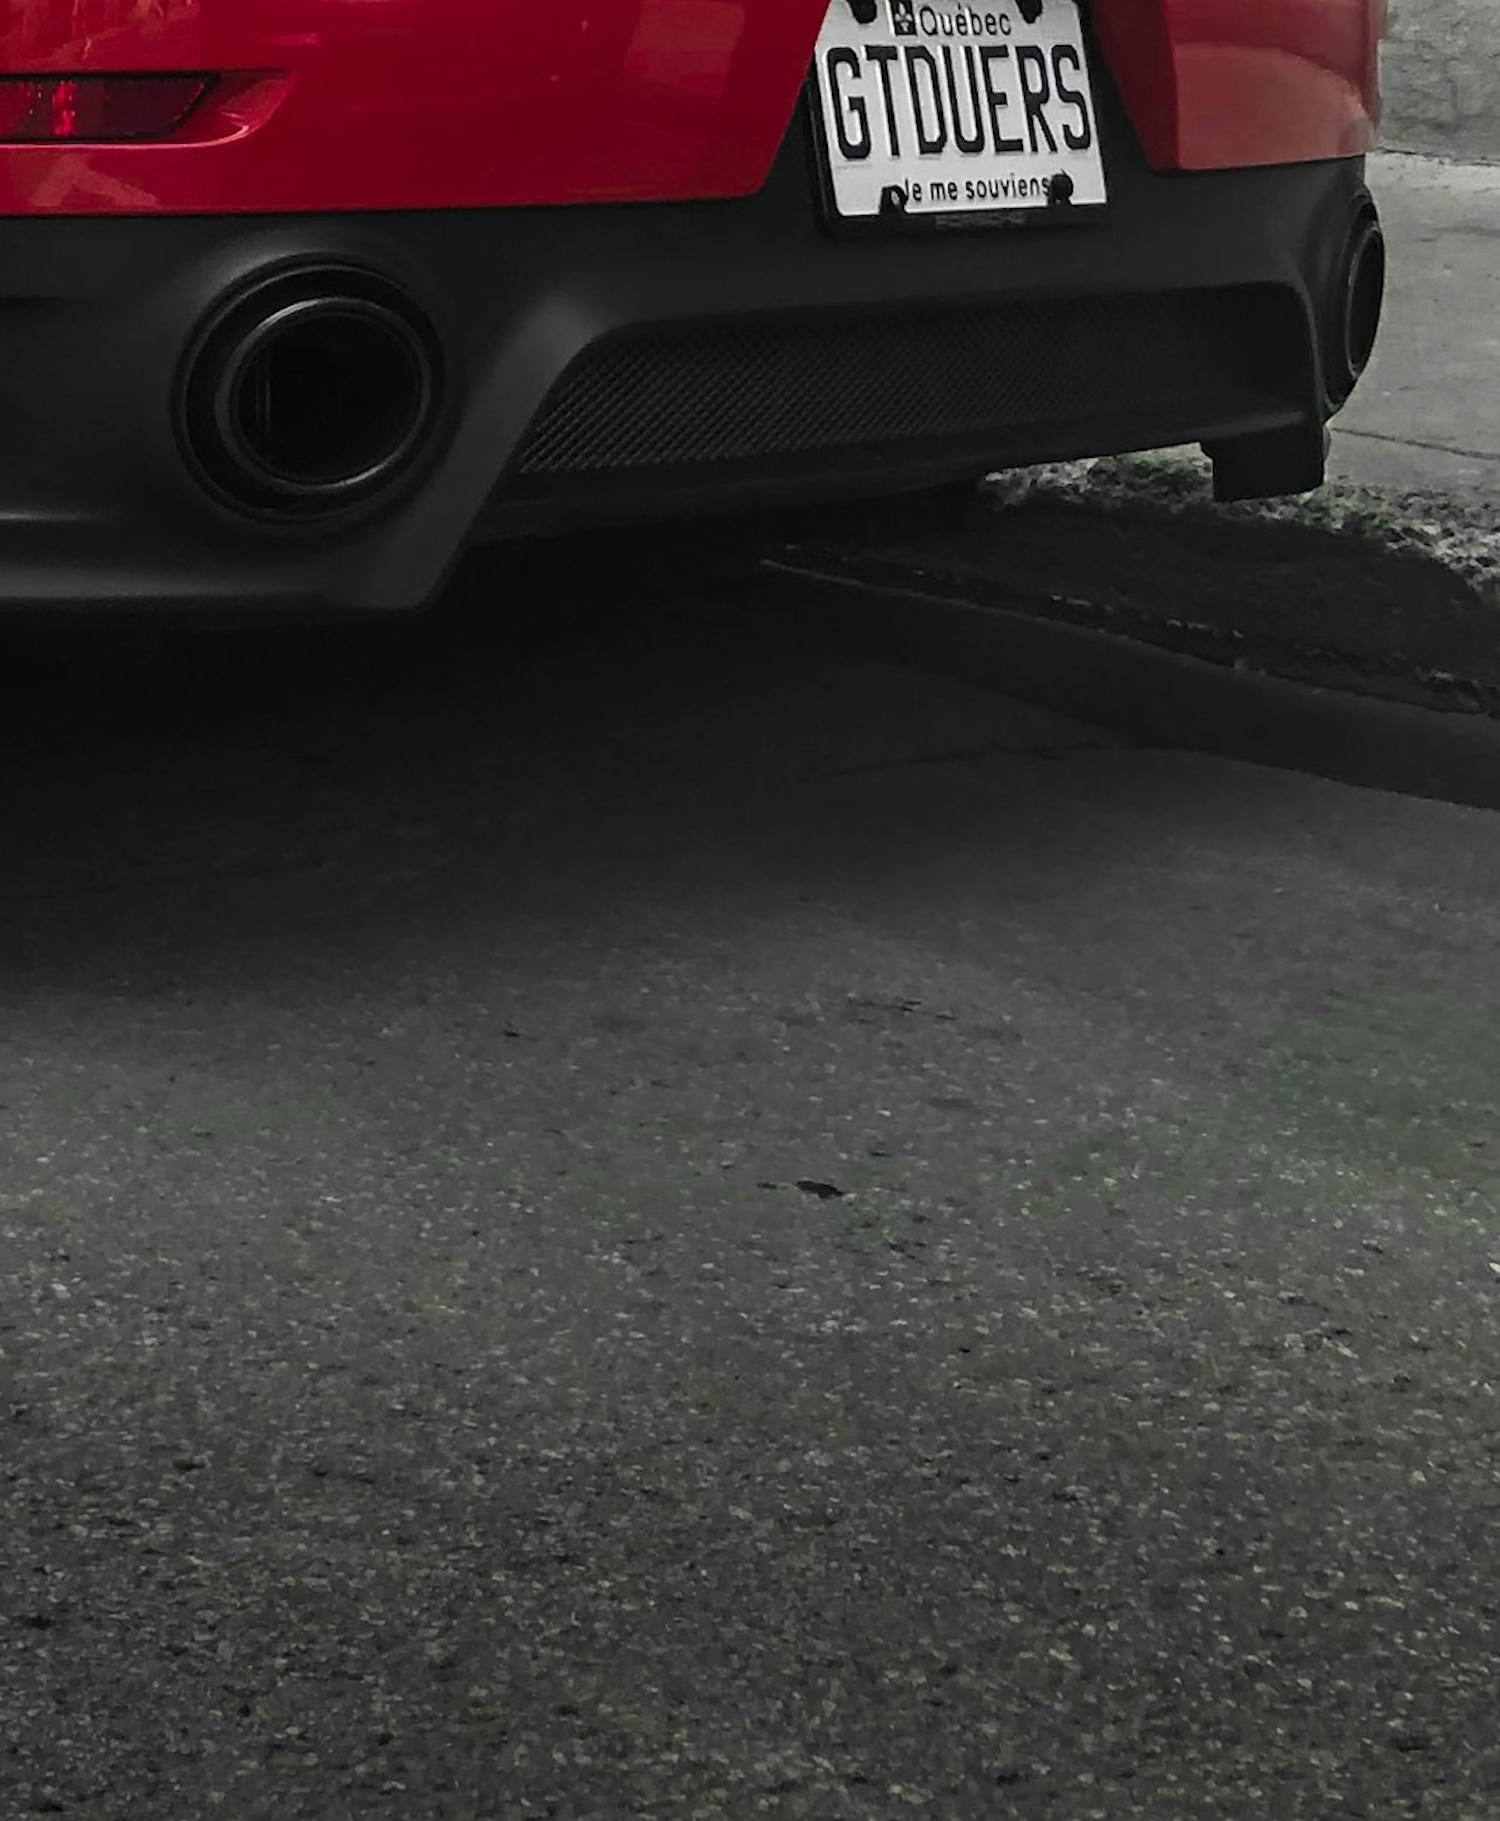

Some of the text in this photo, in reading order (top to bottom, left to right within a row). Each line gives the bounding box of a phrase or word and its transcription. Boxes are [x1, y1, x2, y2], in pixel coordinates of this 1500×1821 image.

[918, 3, 1012, 37] Québec
[826, 44, 1092, 160] GTDUERS
[902, 173, 1049, 201] Je me souviens
